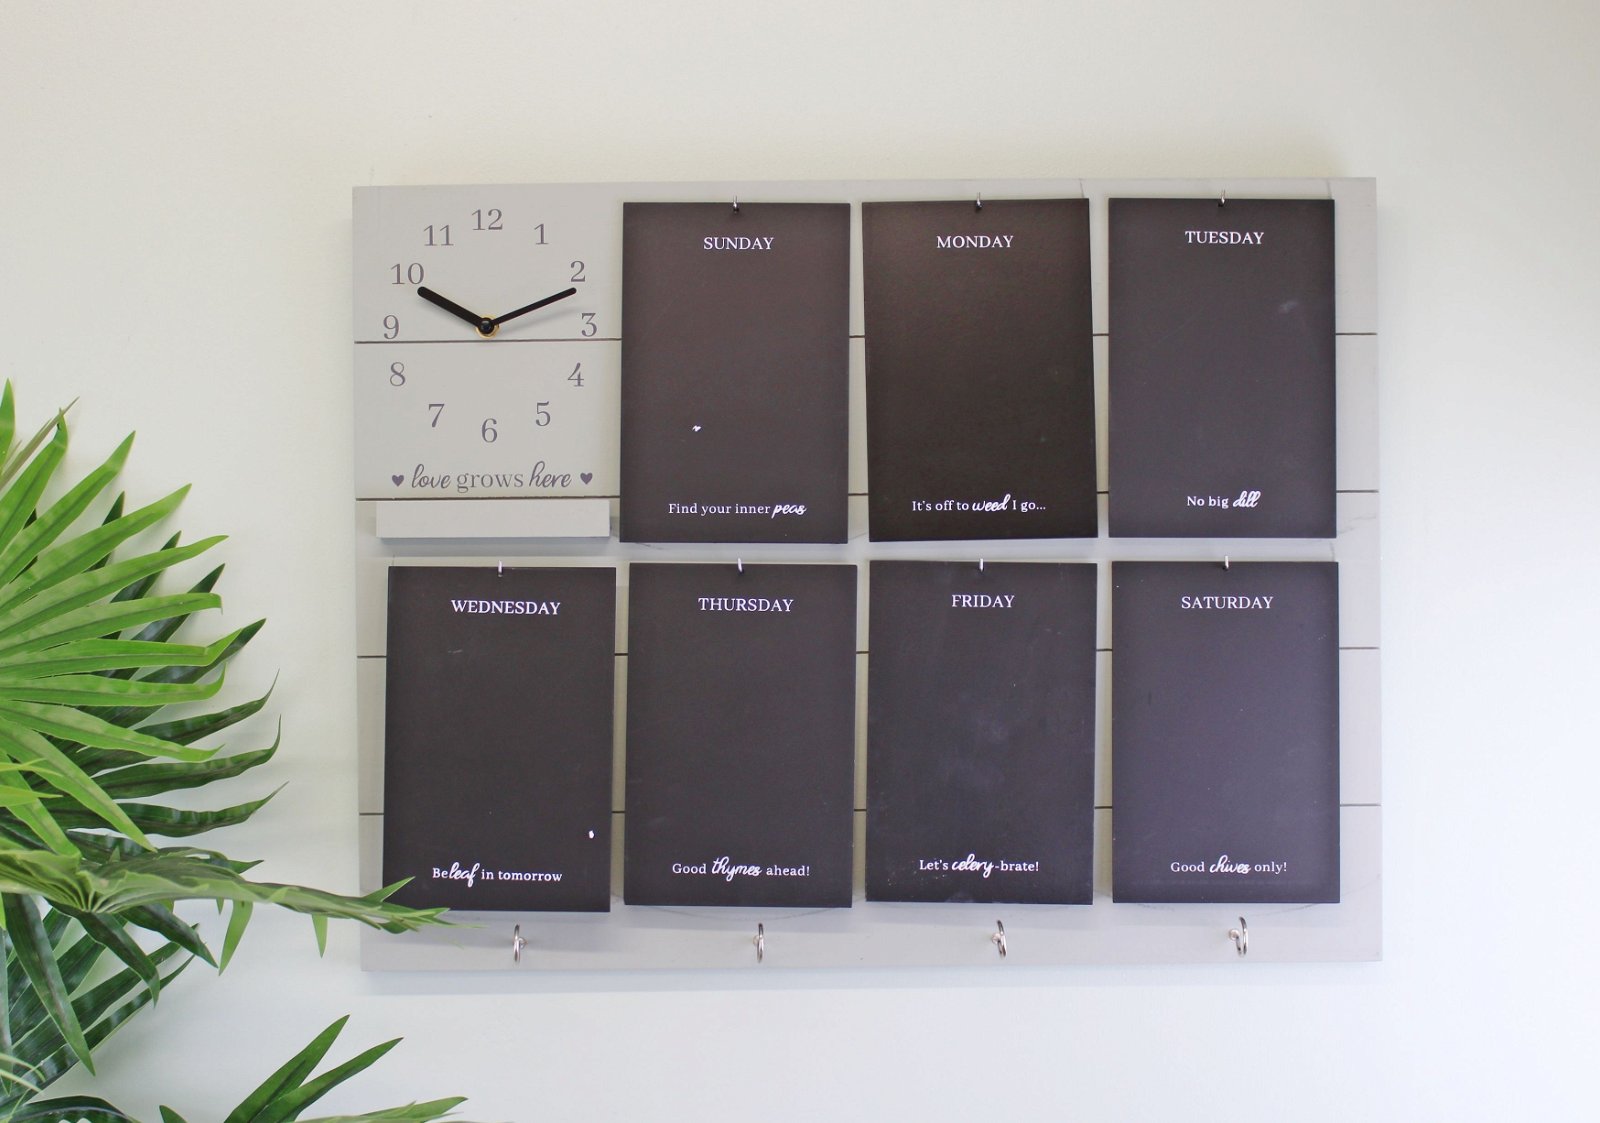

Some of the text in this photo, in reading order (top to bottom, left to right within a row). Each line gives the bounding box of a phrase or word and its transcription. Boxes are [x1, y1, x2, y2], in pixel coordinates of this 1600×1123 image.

[472, 209, 502, 230] 12
[424, 225, 453, 246] 11
[535, 224, 548, 245] 1
[704, 237, 774, 249] SUNDAY
[937, 236, 1013, 248] MONDAY
[1185, 231, 1264, 244] TUESDAY
[391, 263, 424, 284] 10
[571, 261, 585, 282] 2
[383, 315, 399, 339] 9
[582, 313, 597, 337] 3
[390, 362, 405, 386] 8
[568, 363, 584, 387] 4
[429, 404, 444, 427] 7
[536, 401, 550, 426] 5
[482, 418, 497, 442] 6
[412, 461, 572, 493] love grows here
[669, 503, 806, 518] Find your inner peas
[913, 494, 1045, 512] It's off to weed I go...
[1187, 491, 1260, 509] No big dill
[451, 600, 560, 615] WEDNESDAY
[698, 598, 793, 611] THURSDAY
[952, 595, 1014, 607] FRIDAY
[1182, 596, 1273, 609] SATURDAY
[481, 869, 494, 879] in
[498, 871, 562, 881] tomorrow
[673, 856, 809, 881] Good thymes ahead!
[920, 860, 948, 870] Let's
[1171, 855, 1286, 874] Good chives only!
